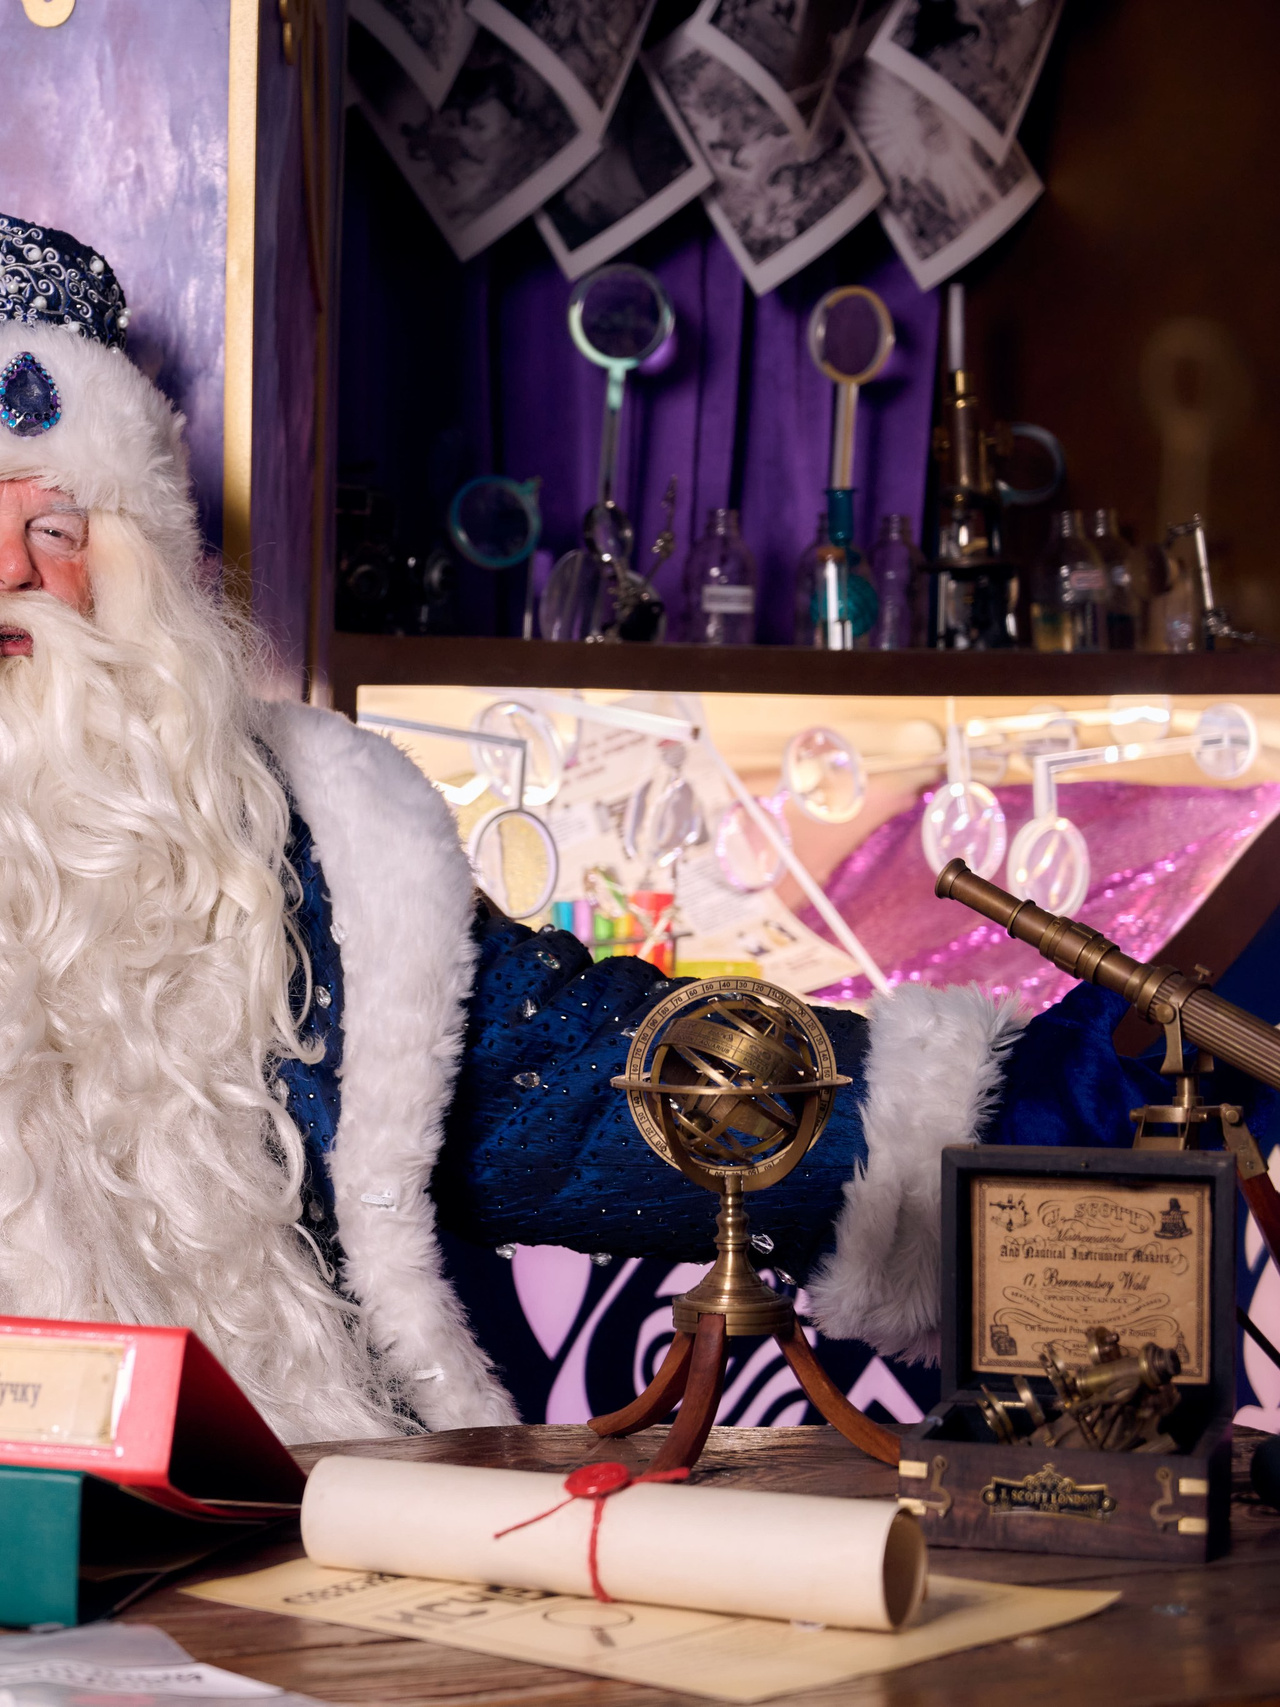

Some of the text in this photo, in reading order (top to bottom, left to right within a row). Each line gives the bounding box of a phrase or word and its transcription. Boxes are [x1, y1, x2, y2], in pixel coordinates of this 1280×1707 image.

[705, 983, 714, 991] 50
[755, 984, 764, 992] 20
[689, 988, 698, 997] 60
[673, 997, 683, 1005] 70
[660, 1006, 670, 1015] 80
[649, 1018, 658, 1028] 90
[808, 1022, 817, 1031] 20
[640, 1032, 649, 1041] 80
[816, 1036, 824, 1046] 30
[634, 1047, 642, 1056] 70
[700, 1040, 730, 1054] AQUARIUS
[821, 1053, 829, 1062] 40
[631, 1063, 639, 1072] 60
[633, 1096, 640, 1105] 40
[645, 1127, 654, 1136] 20
[1054, 1229, 1127, 1244] Mathematical
[1000, 1244, 1020, 1258] And
[1023, 1246, 1066, 1259] Nautical
[1071, 1247, 1128, 1261] Instrument
[1042, 1267, 1115, 1296] Bermondsey
[1119, 1271, 1151, 1291] Wall
[1011, 1490, 1048, 1504] SCOTT
[1050, 1491, 1099, 1506] LONDON
